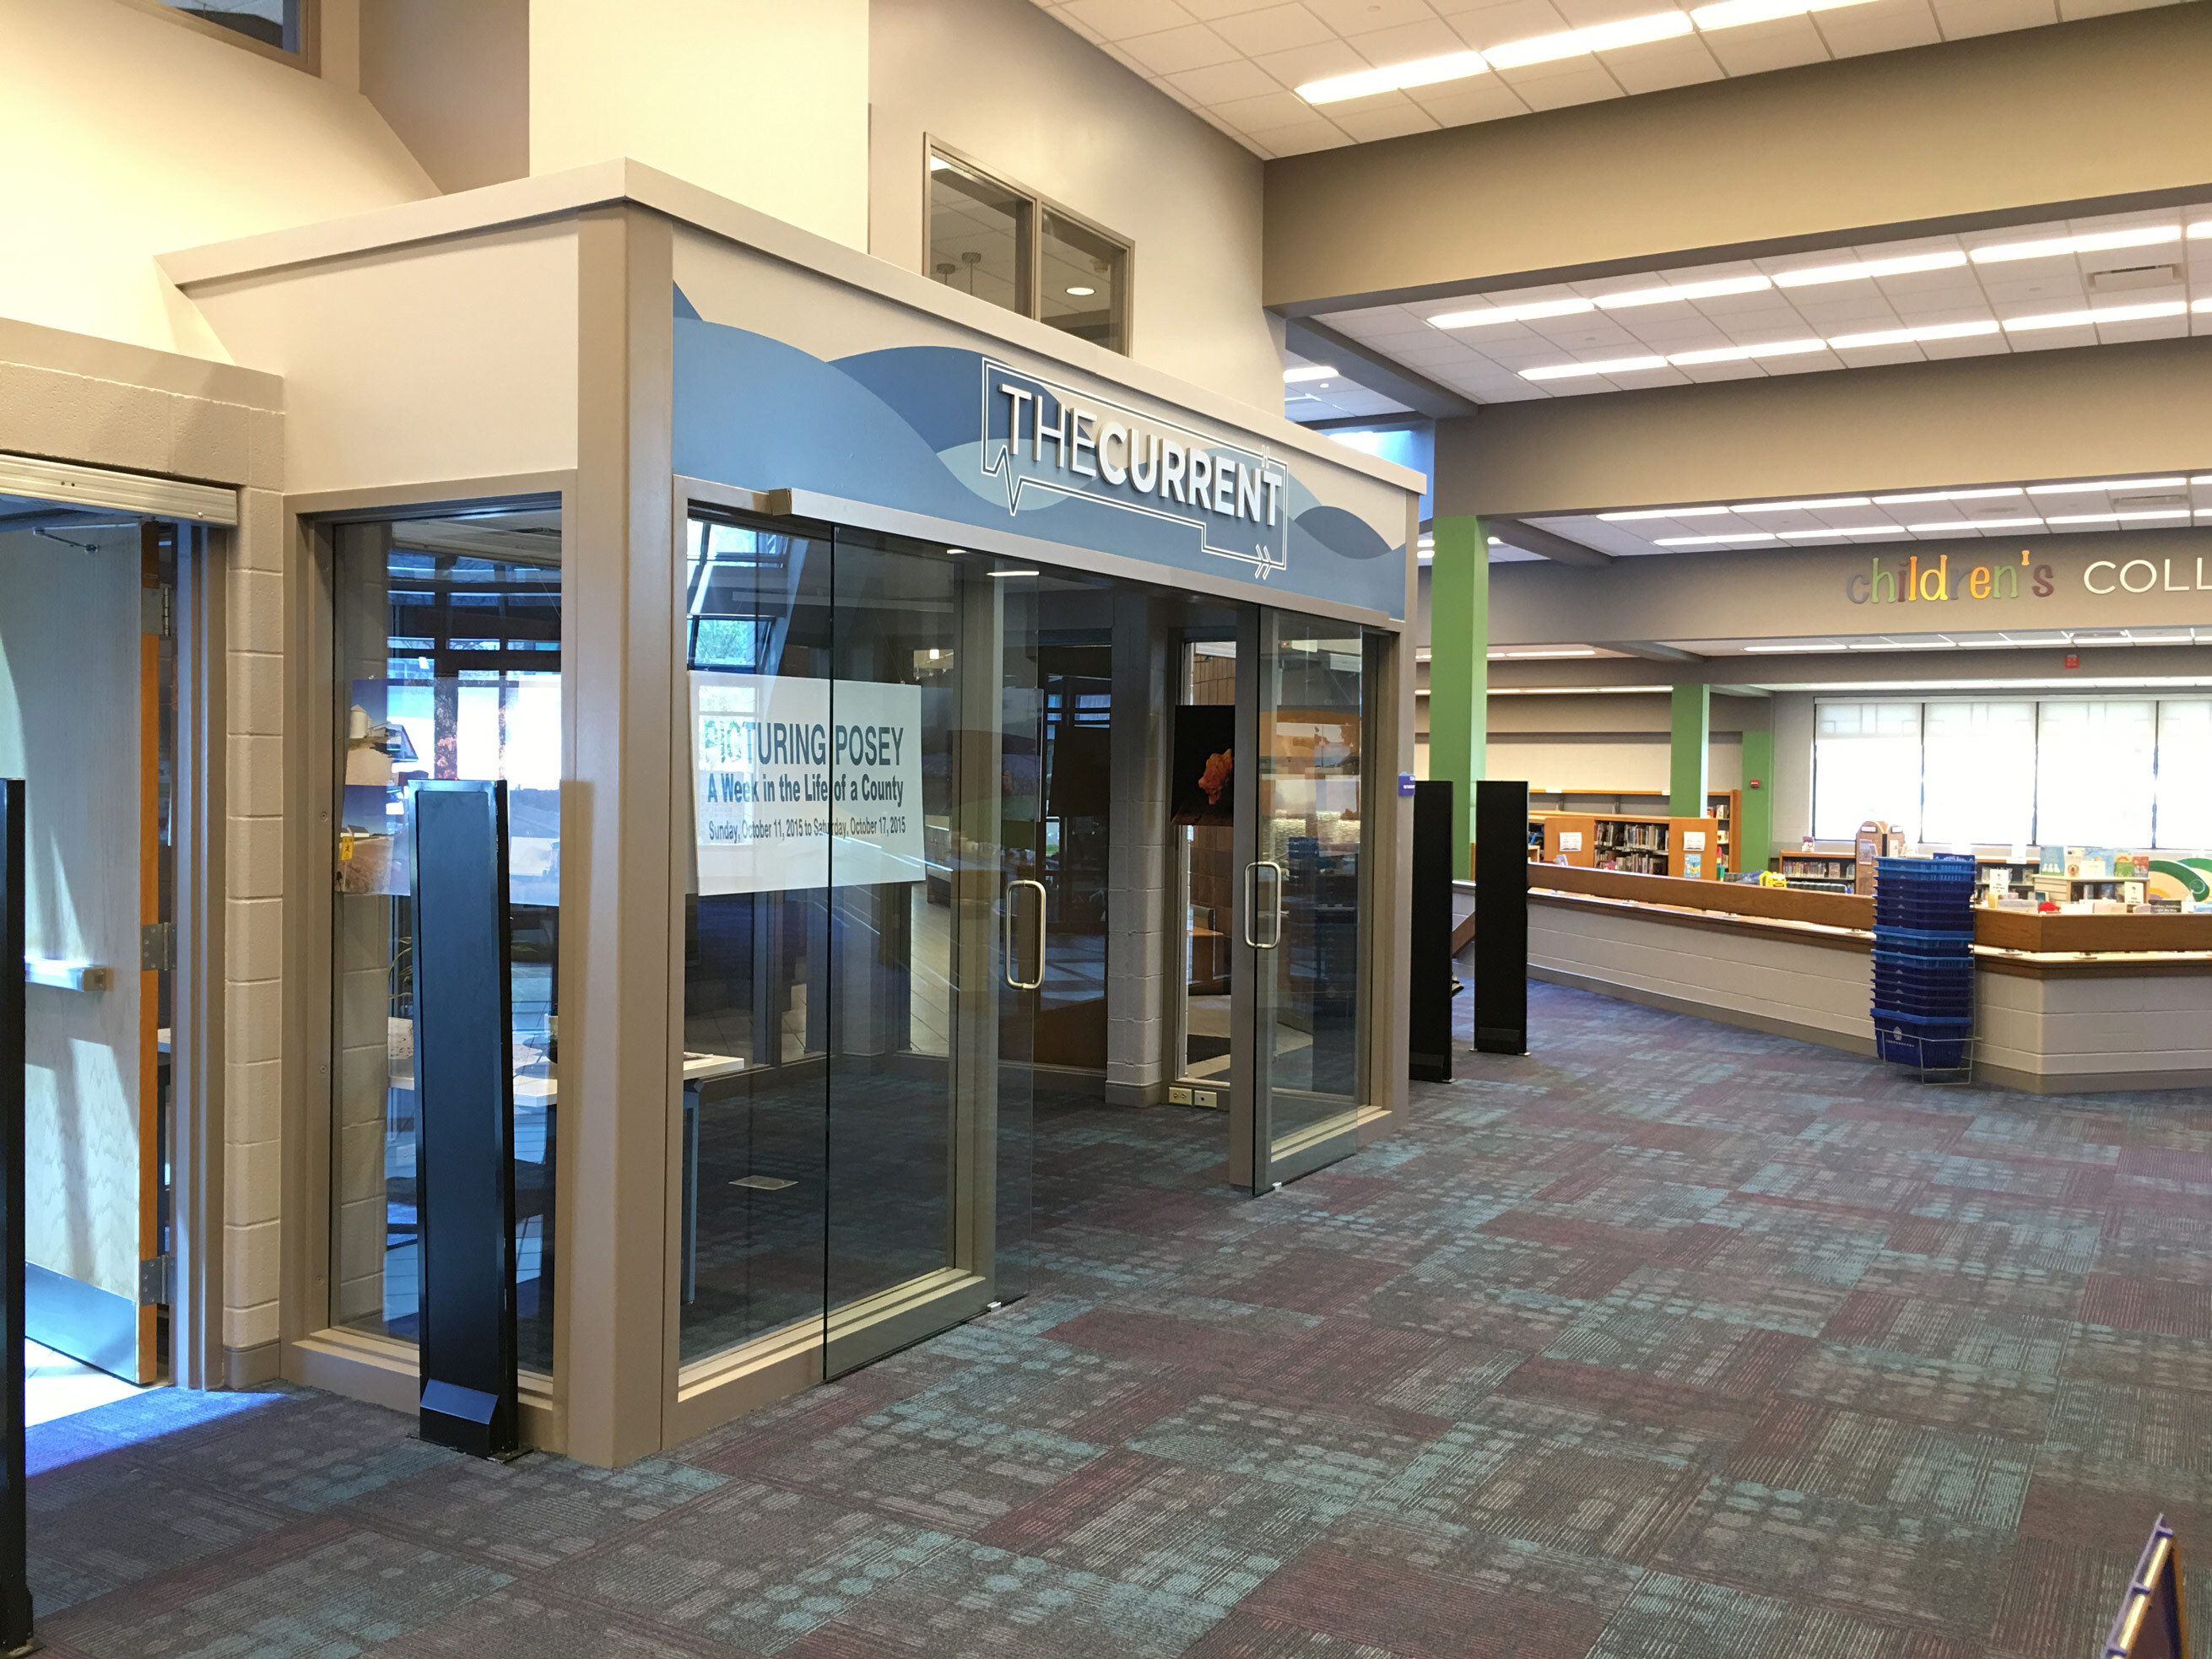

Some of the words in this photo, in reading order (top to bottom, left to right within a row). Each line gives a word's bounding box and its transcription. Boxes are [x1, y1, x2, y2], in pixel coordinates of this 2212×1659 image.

[1847, 549, 2054, 603] children's
[836, 725, 904, 766] POSEY
[707, 773, 718, 802] A
[721, 773, 760, 802] Week
[763, 774, 775, 802] in
[779, 774, 800, 802] the
[804, 774, 828, 802] Life
[834, 774, 846, 802] of
[851, 781, 857, 801] a
[862, 774, 904, 808] County
[709, 820, 741, 844] Sunday,
[742, 819, 771, 839] October
[773, 819, 785, 840] 11,
[787, 819, 803, 837] 2015
[804, 820, 813, 836] to
[851, 817, 877, 835] October
[879, 817, 890, 836] 17,
[890, 816, 906, 834] 2015
